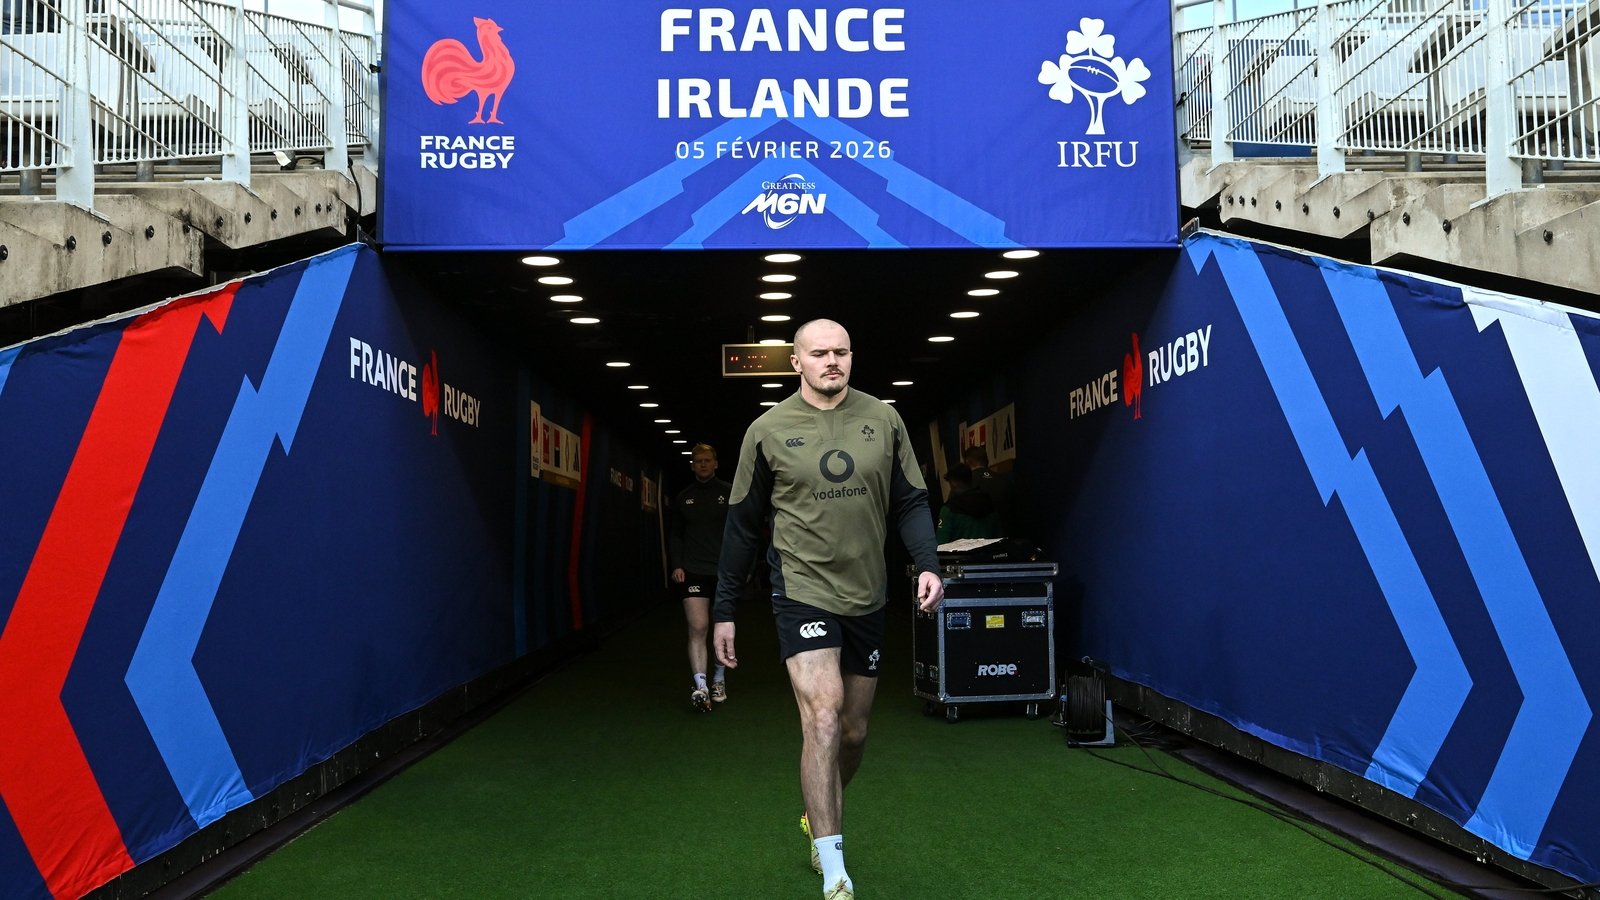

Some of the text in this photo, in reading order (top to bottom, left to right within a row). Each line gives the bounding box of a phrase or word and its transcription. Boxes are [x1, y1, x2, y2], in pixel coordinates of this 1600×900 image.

[661, 8, 905, 51] FRANCE
[658, 78, 909, 118] IRLANDE
[420, 136, 514, 151] FRANCE
[676, 136, 891, 159] 05 FÉVRIER 2026
[1057, 141, 1138, 168] IRFU
[420, 152, 514, 169] RUGBY
[350, 337, 481, 428] FRANCE RUGBY
[1069, 324, 1212, 420] FRANCE RUGBY
[812, 486, 867, 501] vodafone
